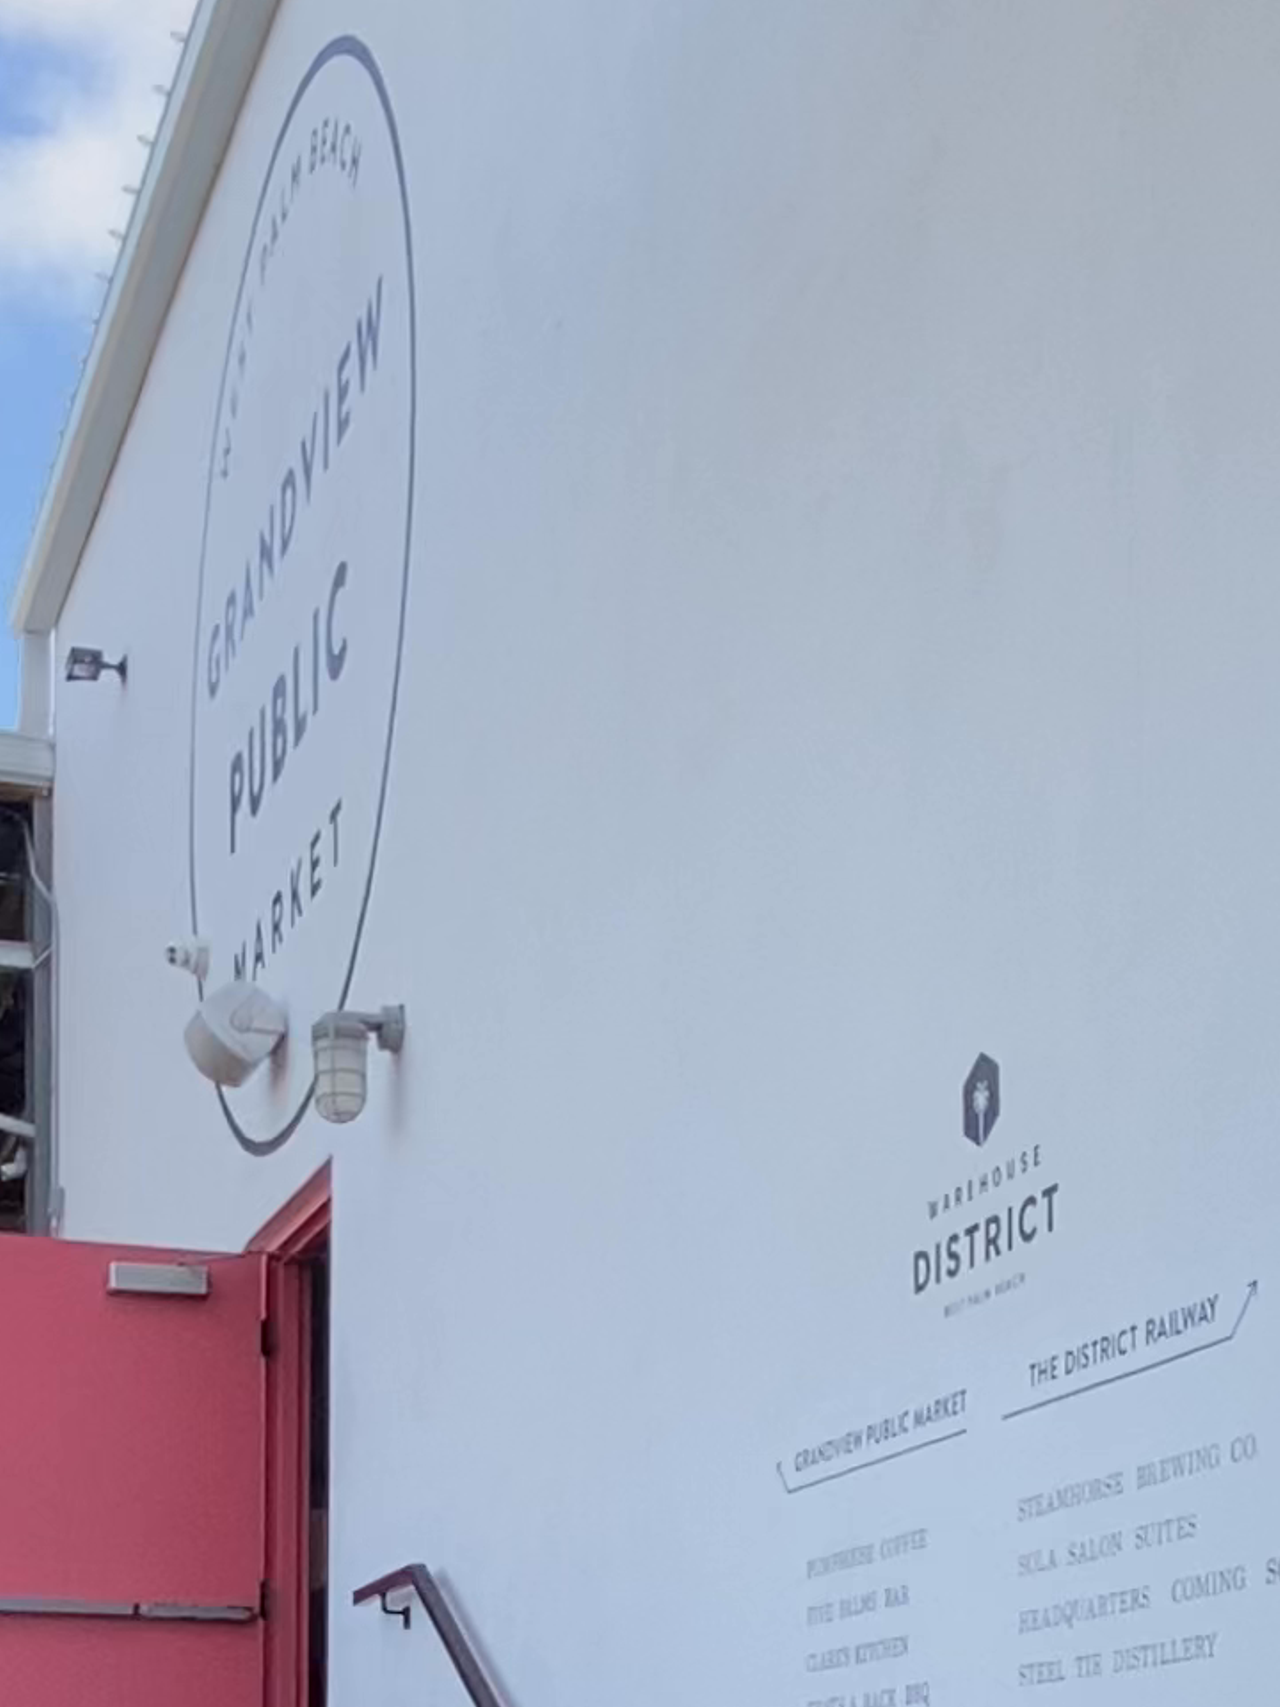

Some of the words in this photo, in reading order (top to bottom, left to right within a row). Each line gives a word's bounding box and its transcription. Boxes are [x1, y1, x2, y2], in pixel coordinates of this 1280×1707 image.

[258, 154, 302, 285] PALM
[308, 116, 362, 189] BEACH
[207, 274, 383, 700] GRANDVIEW
[229, 560, 348, 855] PUBLIC
[233, 798, 343, 983] MARKET
[926, 1144, 1041, 1220] WAREHOUSE
[912, 1182, 1060, 1295] DISTRICT
[1028, 1355, 1059, 1388] THE
[1064, 1325, 1139, 1376] DISTRICT
[1144, 1293, 1220, 1347] RAILWAY
[793, 1430, 864, 1473] GRANDVIEW
[866, 1410, 910, 1448] PUBLIC
[912, 1388, 968, 1430] MARKET
[1016, 1471, 1125, 1523] STEAMHORSE
[1136, 1443, 1221, 1490] BREWING
[1066, 1530, 1124, 1566] SALON
[1134, 1513, 1198, 1550] SUITES
[1018, 1585, 1151, 1635] HEADQUARTERS
[1170, 1564, 1248, 1604] COMING
[1018, 1659, 1066, 1687] STEEL
[1075, 1653, 1102, 1678] TIE
[1112, 1632, 1219, 1674] DISTILLERY
